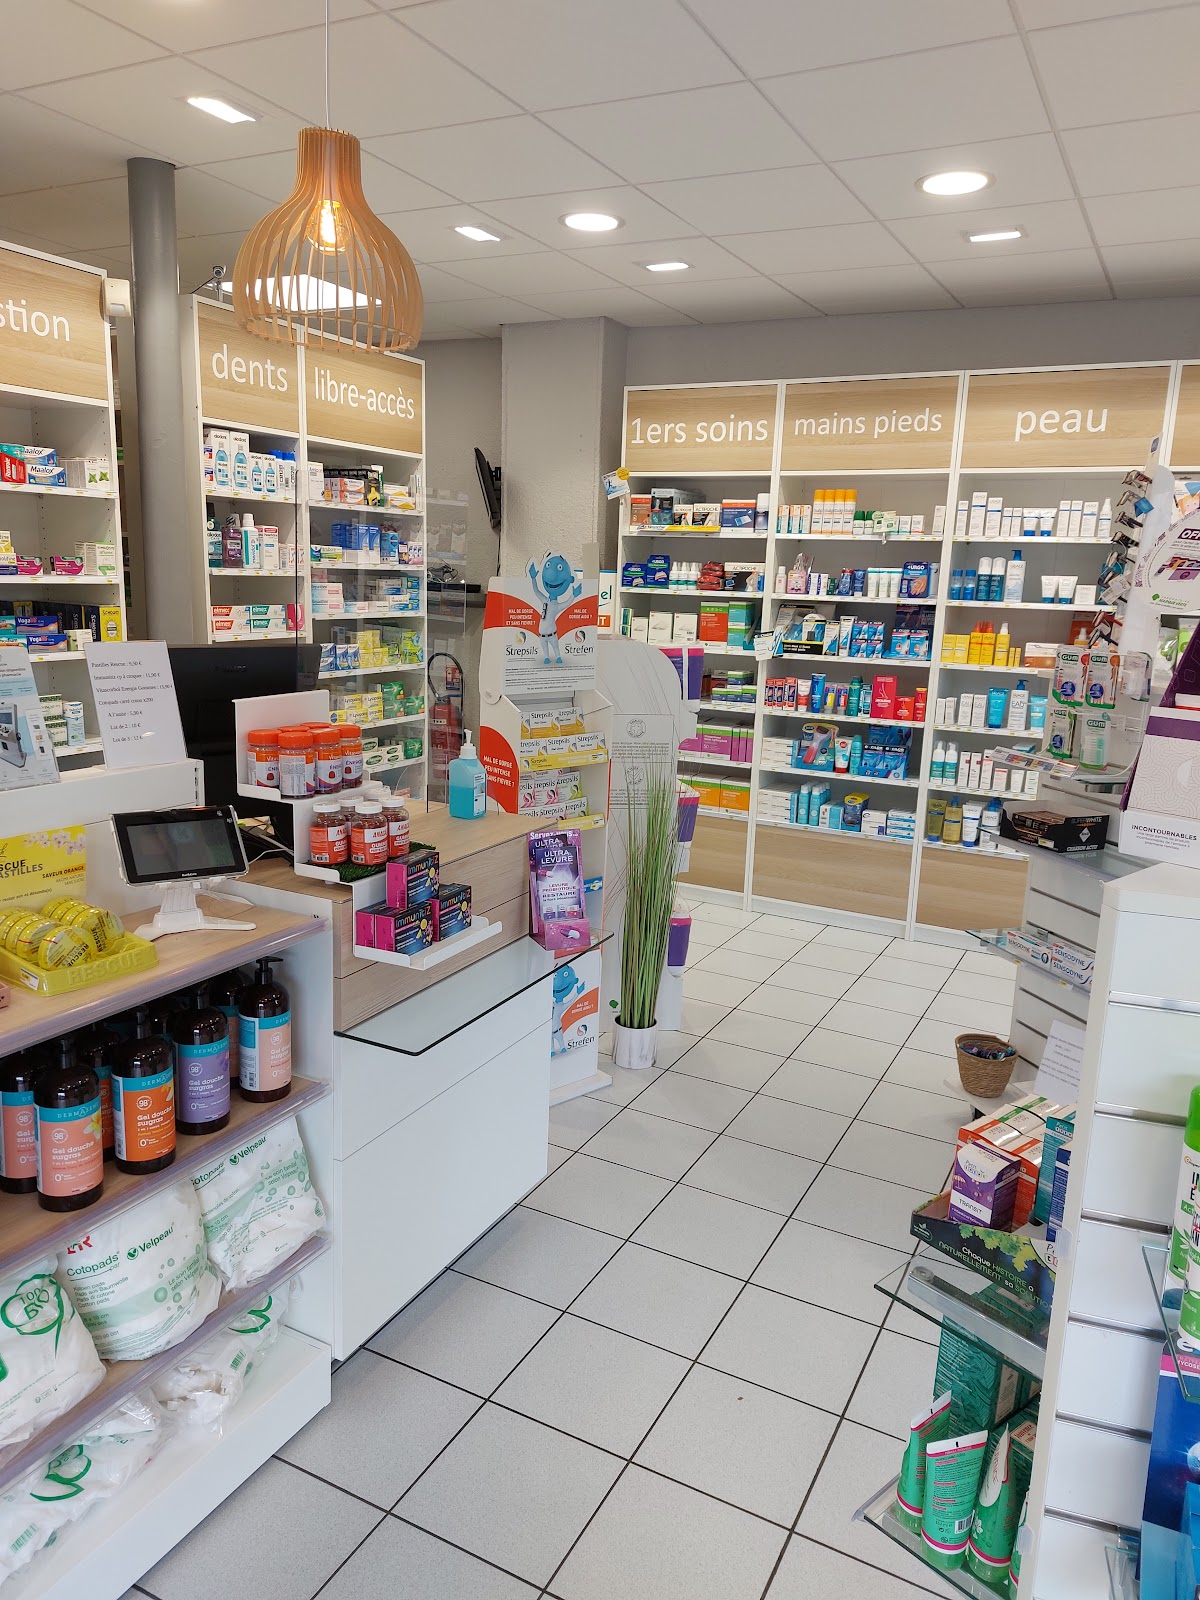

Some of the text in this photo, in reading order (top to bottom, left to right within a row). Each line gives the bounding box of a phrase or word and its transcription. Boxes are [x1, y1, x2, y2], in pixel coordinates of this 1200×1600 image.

[212, 344, 289, 392] dents
[314, 368, 415, 420] libre-accès
[631, 414, 768, 444] 1ers soins
[794, 408, 943, 439] mains pieds
[1015, 408, 1108, 442] peau
[30, 466, 55, 474] Maalox
[506, 646, 538, 657] Strepsils
[565, 645, 594, 654] Strefen
[577, 734, 599, 742] Strepsils
[499, 760, 512, 768] GORGE
[494, 768, 511, 777] INTENSE
[540, 806, 564, 815] Strepsils
[1131, 824, 1197, 840] INCONTOURNABLES
[535, 838, 560, 847] ULTRA
[541, 856, 573, 864] LEVURE
[64, 866, 84, 874] ORANGE
[1008, 939, 1030, 953] SENSODYNE
[1055, 948, 1085, 966] SENSODYNE
[1054, 962, 1083, 980] SENSODYNE
[567, 1036, 595, 1049] Strefen
[202, 1074, 224, 1085] douche
[152, 1106, 172, 1118] douche
[137, 1117, 163, 1126] surgras
[67, 1141, 94, 1153] douche
[238, 1136, 266, 1158] Velpeau
[960, 1199, 983, 1213] TRANSIT
[138, 1226, 174, 1252] Velpeau
[66, 1253, 119, 1277] Cotopads
[110, 1262, 120, 1272] par
[938, 1241, 1002, 1281] NATURELLEMENT
[1004, 1280, 1013, 1288] sa
[962, 1246, 991, 1267] Chaque
[992, 1263, 1027, 1286] HISTOIRE
[176, 1270, 187, 1281] soin
[100, 1276, 128, 1292] Baumwolle
[171, 1280, 184, 1292] selon
